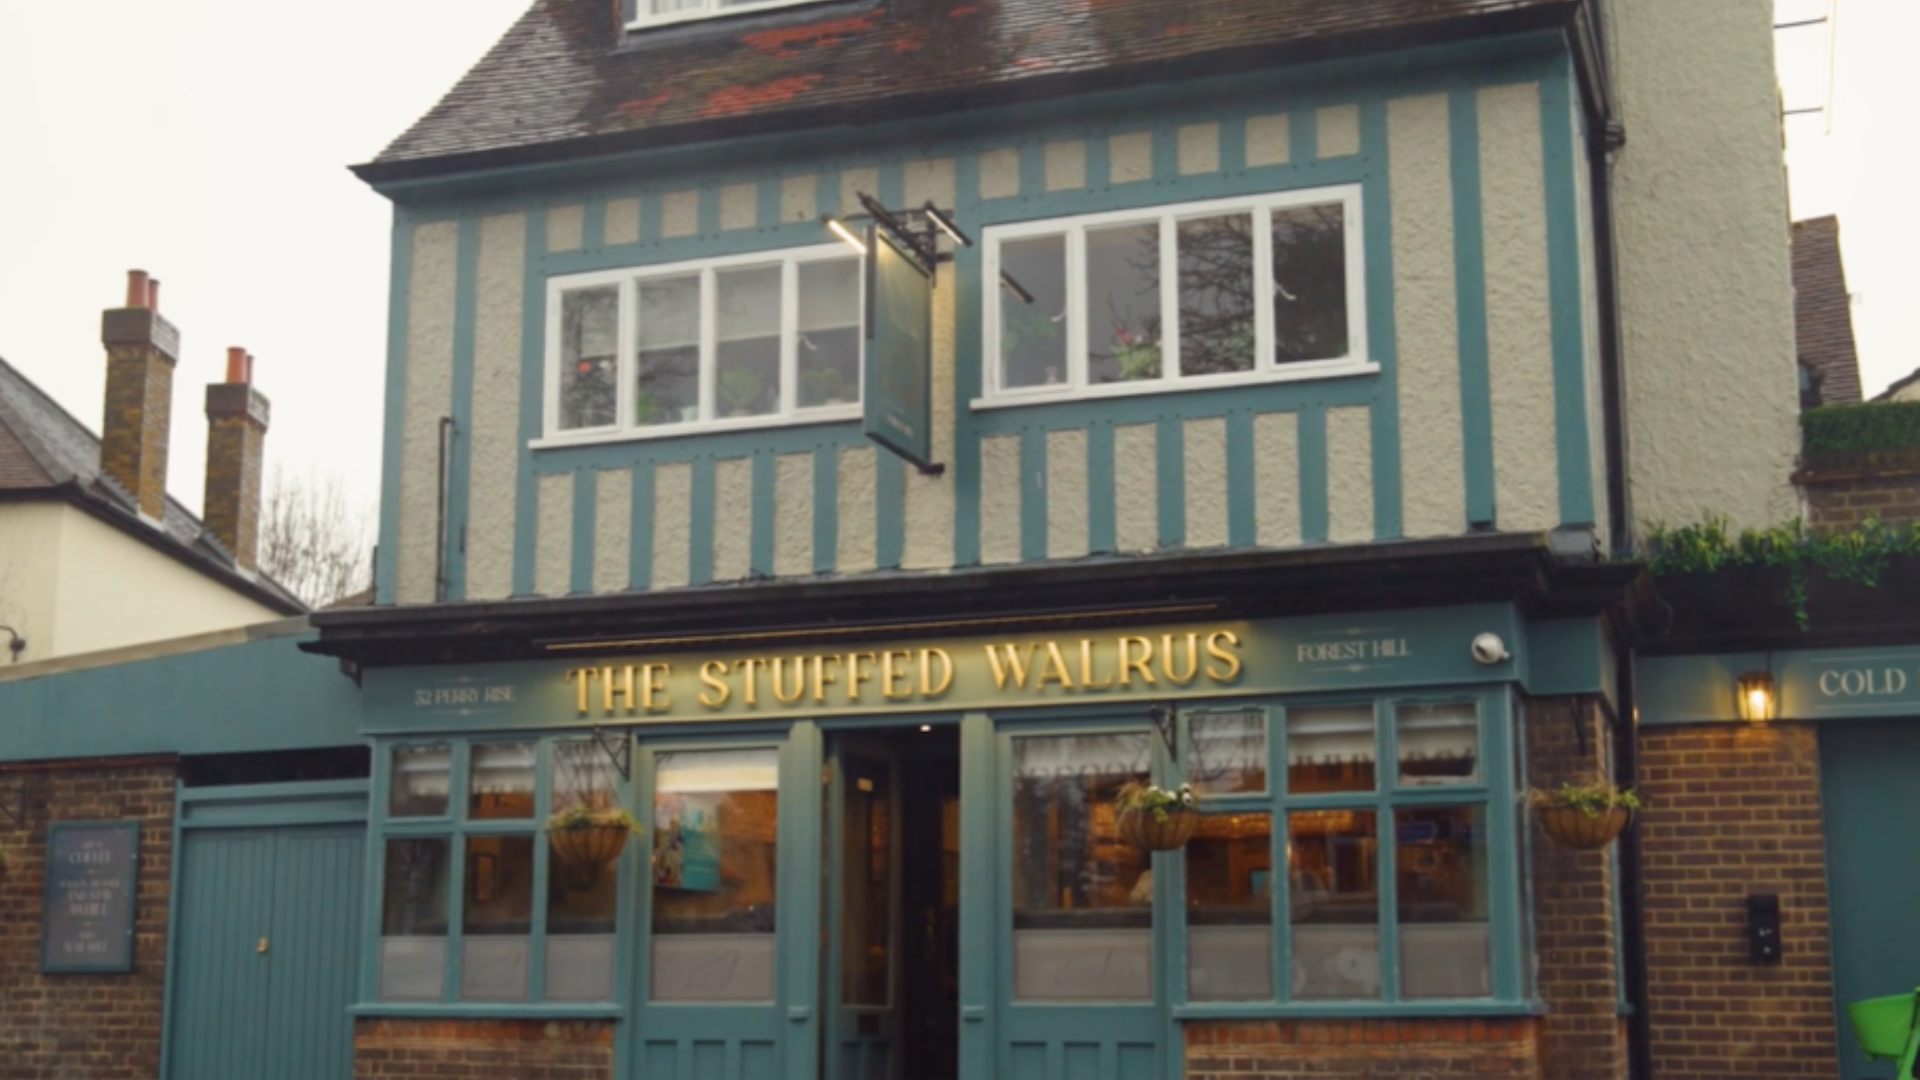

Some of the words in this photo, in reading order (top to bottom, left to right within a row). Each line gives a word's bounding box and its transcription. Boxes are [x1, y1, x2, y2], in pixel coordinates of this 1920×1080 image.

[1297, 641, 1369, 662] FOREST
[1372, 638, 1413, 658] HILL
[565, 662, 671, 713] THE
[699, 648, 953, 706] STUFFED
[984, 630, 1241, 690] WALRUS
[1819, 668, 1907, 696] COLD
[435, 687, 479, 704] PERRY
[484, 684, 517, 702] RISE
